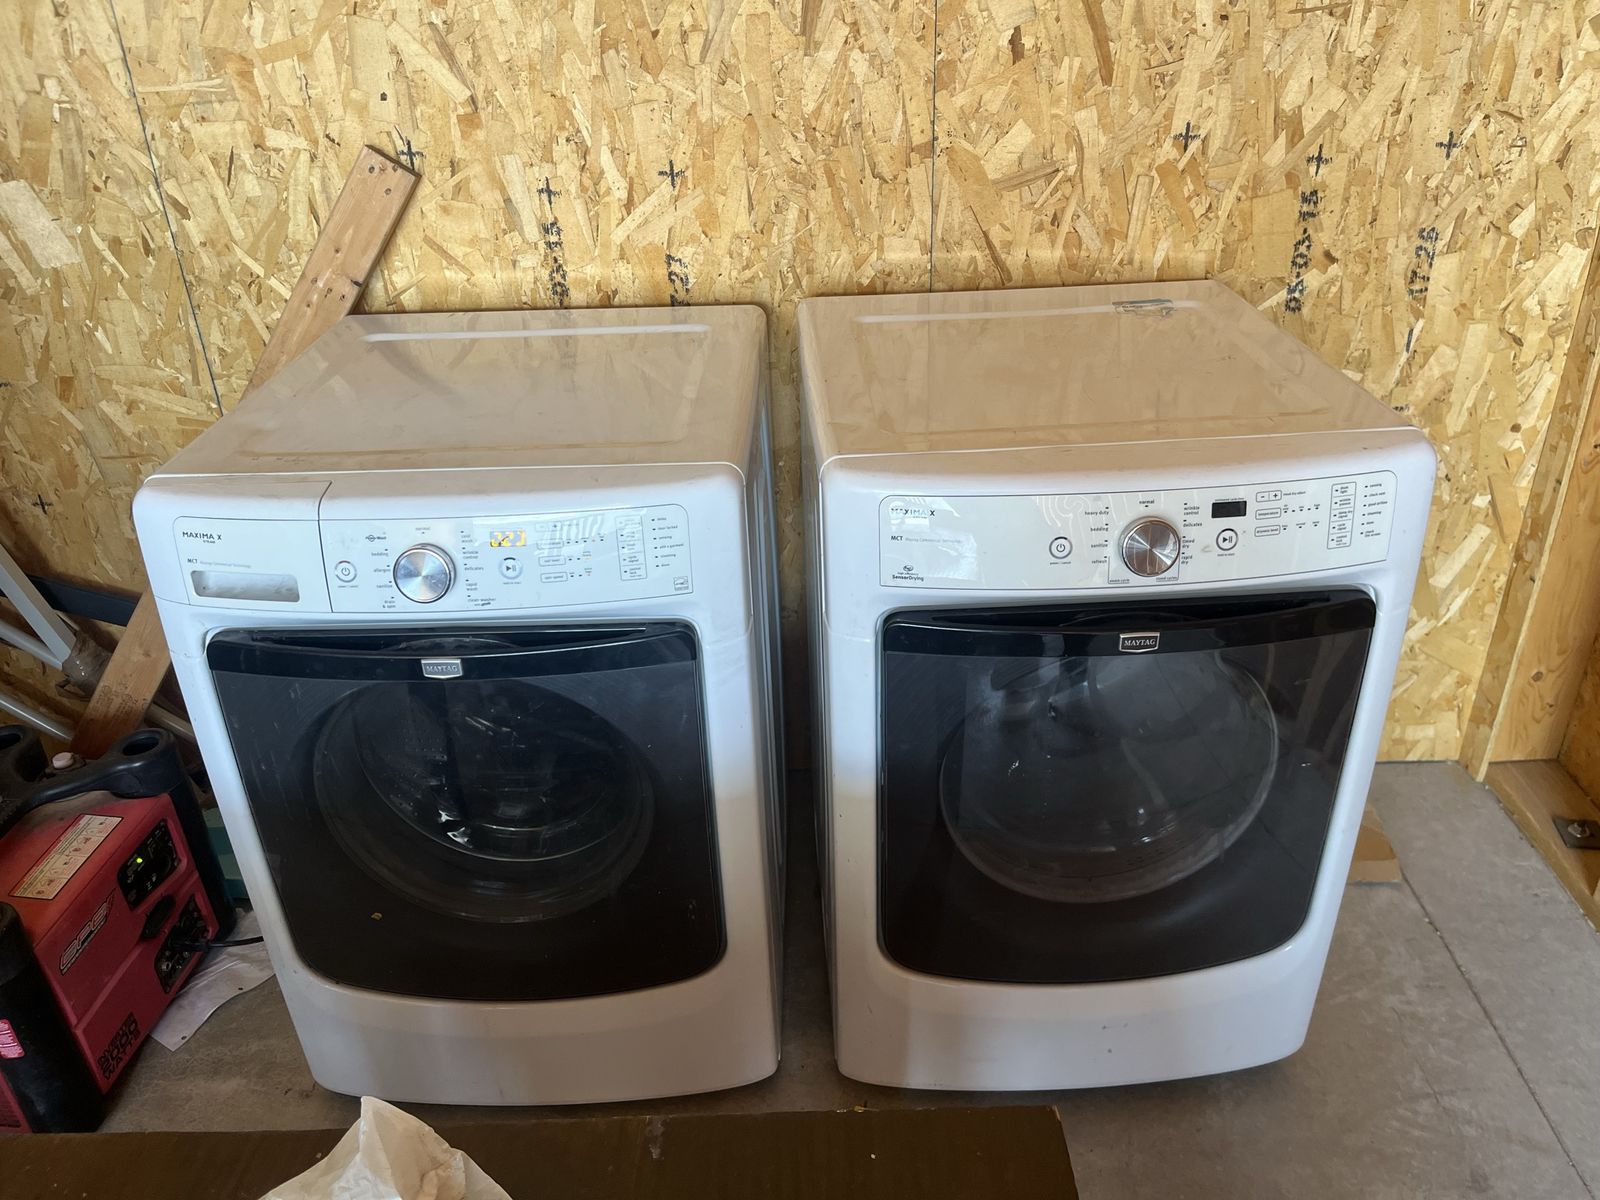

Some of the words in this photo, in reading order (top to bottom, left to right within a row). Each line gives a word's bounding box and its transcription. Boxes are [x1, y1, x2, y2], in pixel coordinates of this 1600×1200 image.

[929, 509, 936, 517] X
[182, 531, 215, 540] MAXIMA
[892, 574, 925, 582] SensorDrying
[1123, 638, 1156, 647] MAYTAG
[426, 665, 458, 673] MAYTAG
[100, 1019, 138, 1074] 2000
[104, 1030, 141, 1080] WATTS
